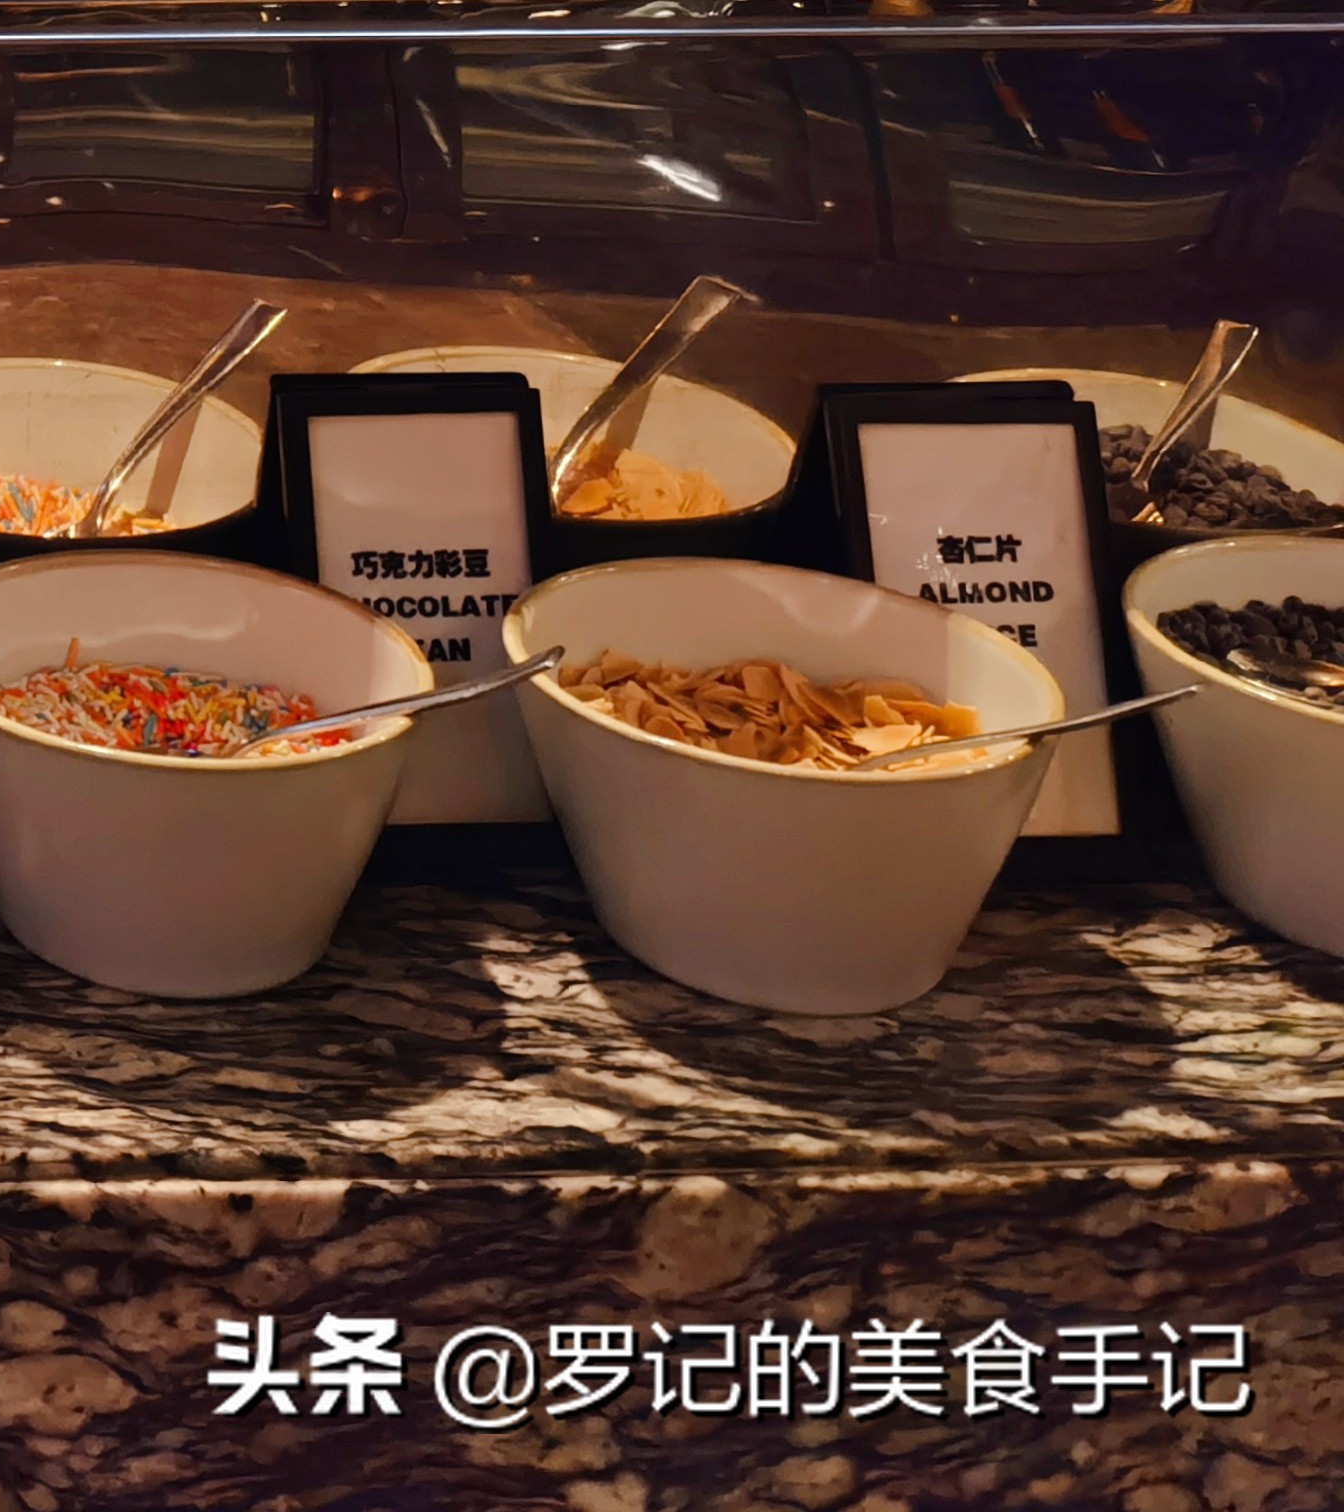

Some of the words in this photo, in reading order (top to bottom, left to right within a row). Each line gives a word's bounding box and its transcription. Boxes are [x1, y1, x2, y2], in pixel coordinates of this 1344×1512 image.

[350, 549, 491, 579] 巧克力彩豆
[936, 534, 1022, 564] 杏仁片
[918, 581, 1054, 604] ALMOND
